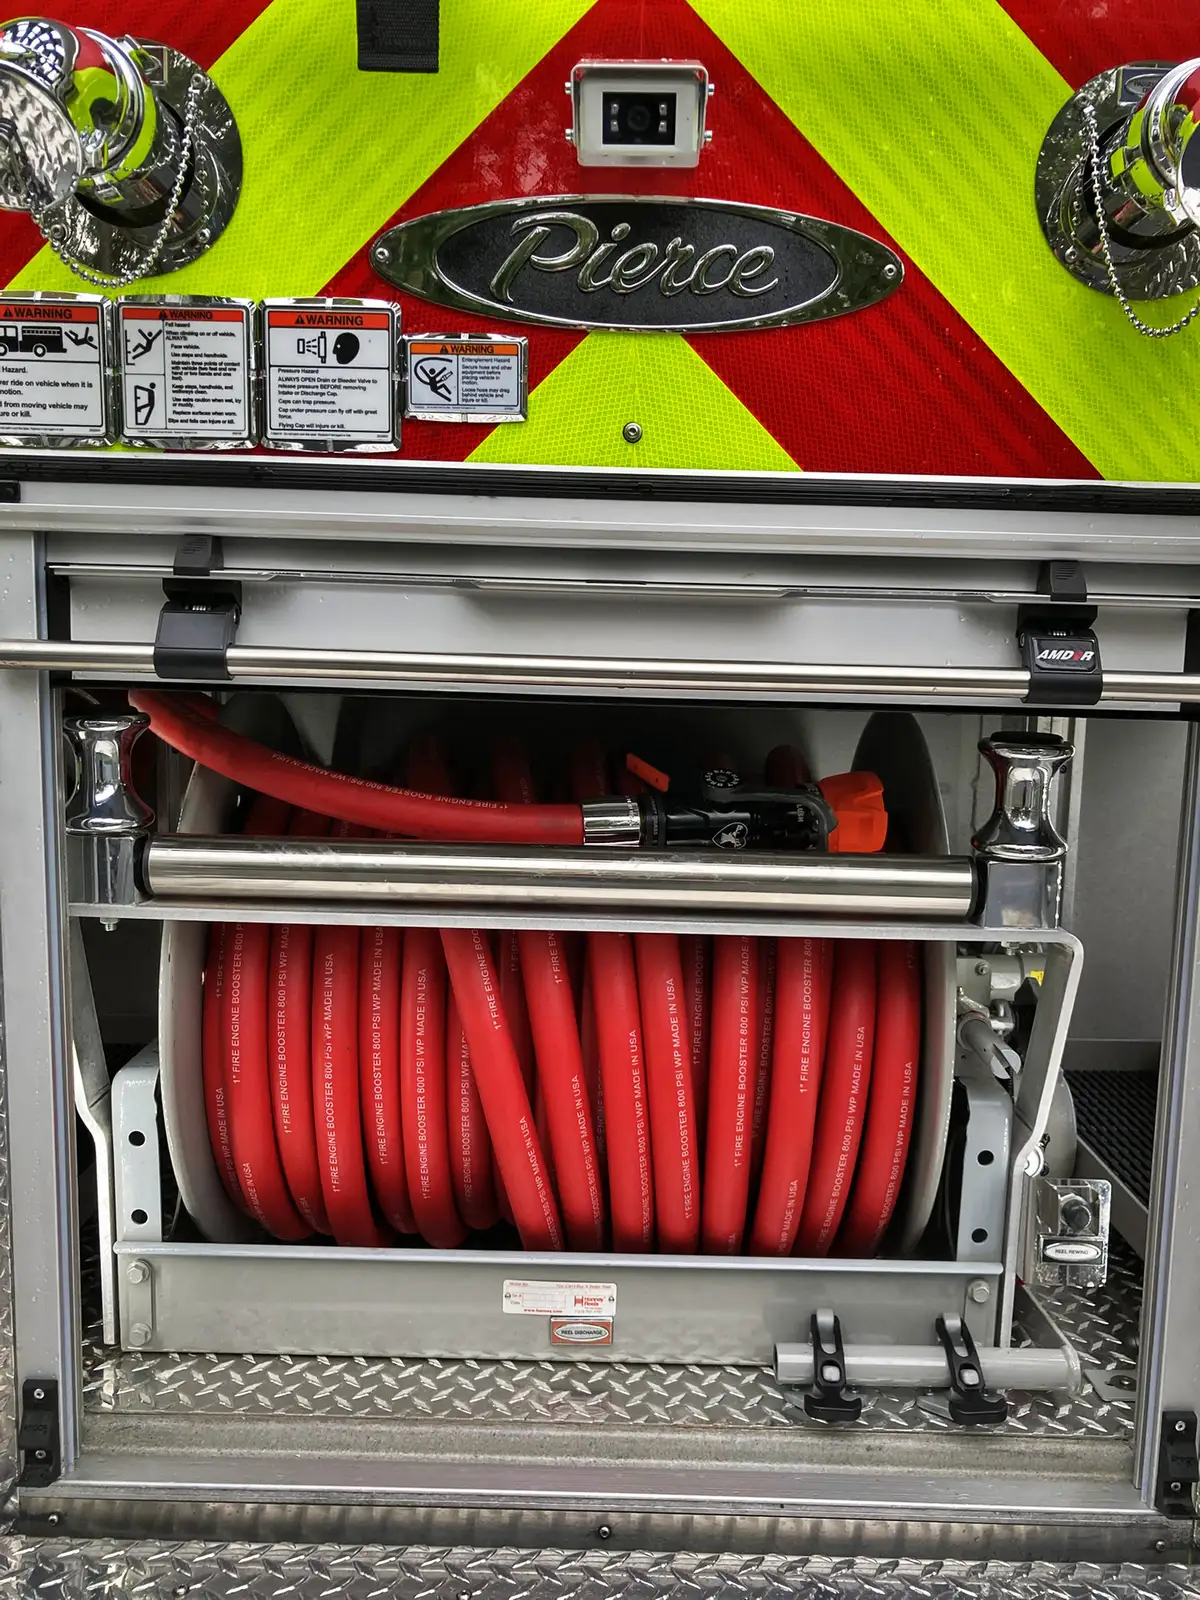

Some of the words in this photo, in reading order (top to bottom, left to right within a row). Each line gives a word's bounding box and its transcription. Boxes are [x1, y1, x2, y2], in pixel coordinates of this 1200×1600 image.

[490, 211, 778, 302] Pierce
[14, 308, 72, 319] WARNING
[170, 311, 213, 319] WARNING
[306, 315, 363, 325] WARNING
[451, 345, 494, 353] WARNING
[271, 752, 290, 764] USA
[291, 759, 300, 767] IN
[302, 762, 327, 776] MADE
[326, 771, 346, 782] WP
[347, 777, 364, 787] PSI
[366, 780, 389, 791] 800
[392, 786, 432, 800] BOOSTER
[435, 796, 472, 807] ENGINE
[475, 801, 498, 809] FIRE
[234, 933, 243, 950] 800
[324, 953, 334, 974] USA
[232, 952, 242, 1004] BOOSTER
[324, 977, 332, 988] IN
[373, 961, 382, 991] MADE
[417, 969, 427, 990] USA
[803, 959, 812, 1010] BOOSTER
[666, 978, 676, 1000] USA
[741, 977, 749, 994] WP
[324, 990, 332, 1020] MADE
[373, 993, 381, 1009] WP
[417, 993, 425, 1003] IN
[741, 996, 749, 1014] PSI
[669, 1003, 677, 1014] IN
[232, 1007, 240, 1047] ENGINE
[372, 1010, 381, 1029] PSI
[417, 1006, 425, 1036] MADE
[740, 1017, 748, 1034] 800
[324, 1023, 332, 1040] WP
[671, 1016, 681, 1047] MADE
[802, 1013, 811, 1054] ENGINE
[324, 1043, 332, 1060] PSI
[416, 1039, 424, 1056] WP
[232, 1050, 240, 1073] FIRE
[673, 1050, 682, 1068] WP
[738, 1037, 748, 1090] BOOSTER
[373, 1052, 382, 1100] BOOSTER
[676, 1069, 684, 1087] PSI
[800, 1057, 809, 1081] FIRE
[417, 1077, 425, 1094] 800
[325, 1082, 335, 1128] BOOSTER
[677, 1089, 685, 1107] 800
[375, 1102, 385, 1136] ENGINE
[417, 1095, 427, 1141] BOOSTER
[736, 1093, 746, 1132] ENGINE
[678, 1109, 689, 1157] BOOSTER
[328, 1131, 338, 1165] ENGINE
[378, 1137, 387, 1156] FIRE
[419, 1143, 429, 1175] ENGINE
[330, 1165, 339, 1185] FIRE
[421, 1175, 430, 1192] FIRE
[682, 1159, 692, 1193] ENGINE
